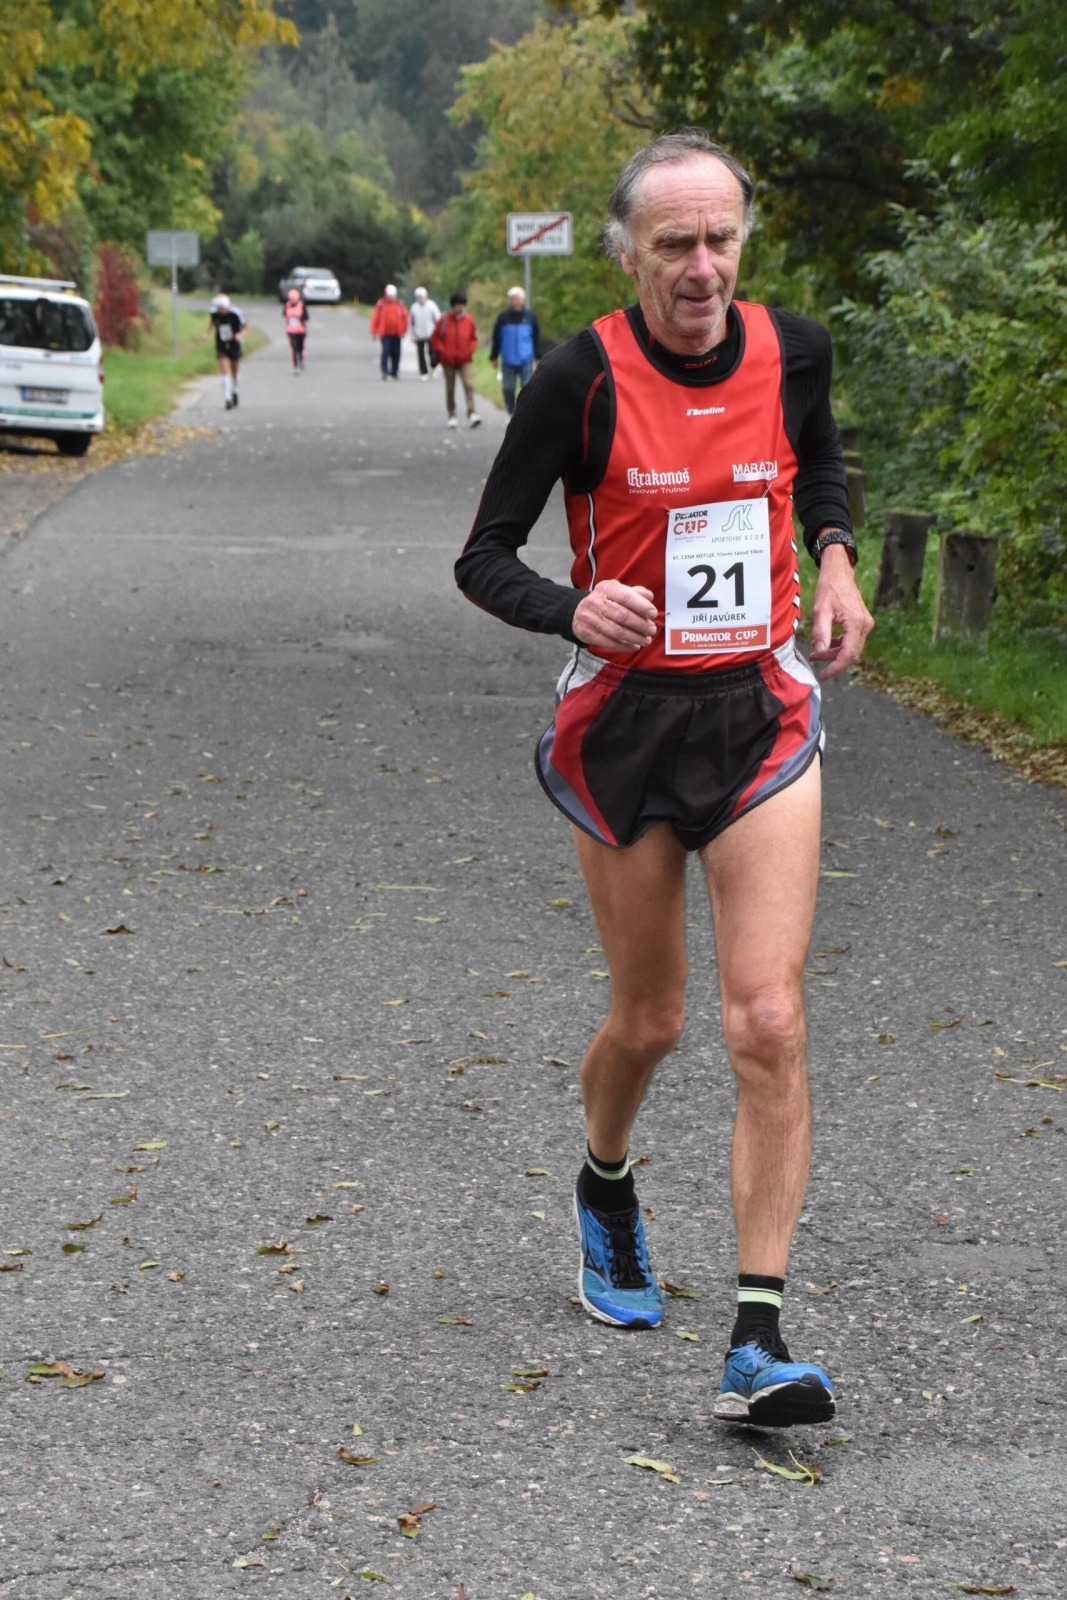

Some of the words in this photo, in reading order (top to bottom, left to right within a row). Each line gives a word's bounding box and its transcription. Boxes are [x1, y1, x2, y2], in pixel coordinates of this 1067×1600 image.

[627, 467, 690, 487] Krakonoš
[660, 486, 690, 494] Trutnov
[673, 519, 708, 535] CUP
[687, 562, 745, 608] 21
[692, 612, 707, 623] JIŘÍ
[681, 631, 731, 643] PRIMATOR
[735, 630, 758, 640] CUP
